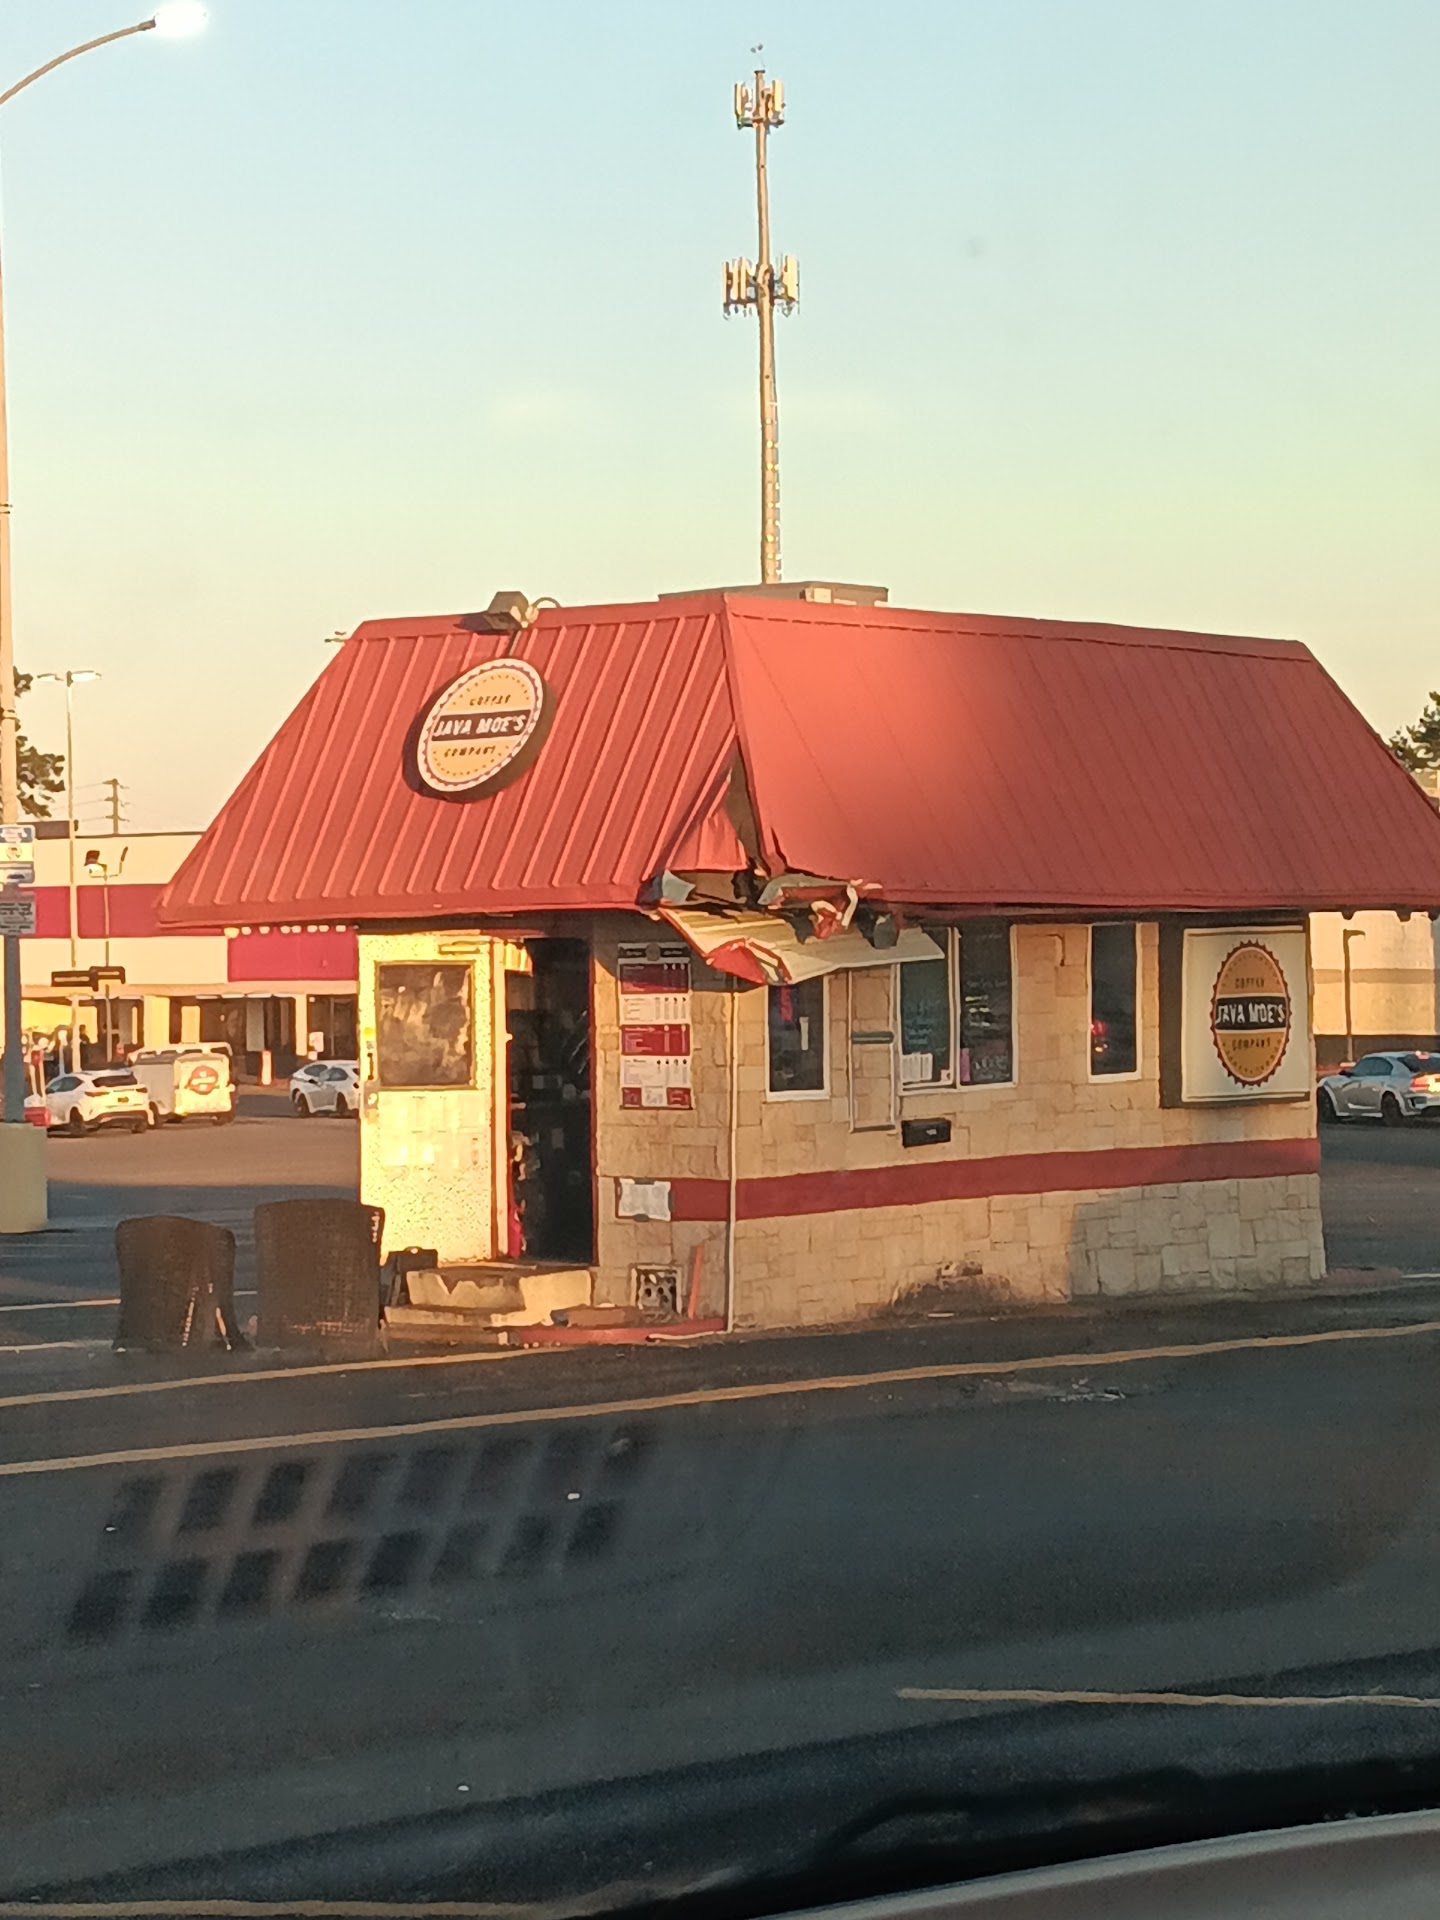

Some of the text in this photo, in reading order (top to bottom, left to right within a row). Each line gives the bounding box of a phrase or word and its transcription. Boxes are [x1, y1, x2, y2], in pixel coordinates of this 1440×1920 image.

[433, 715, 526, 737] JAVA MOE'S
[1216, 1002, 1285, 1025] JAVA MOE'S
